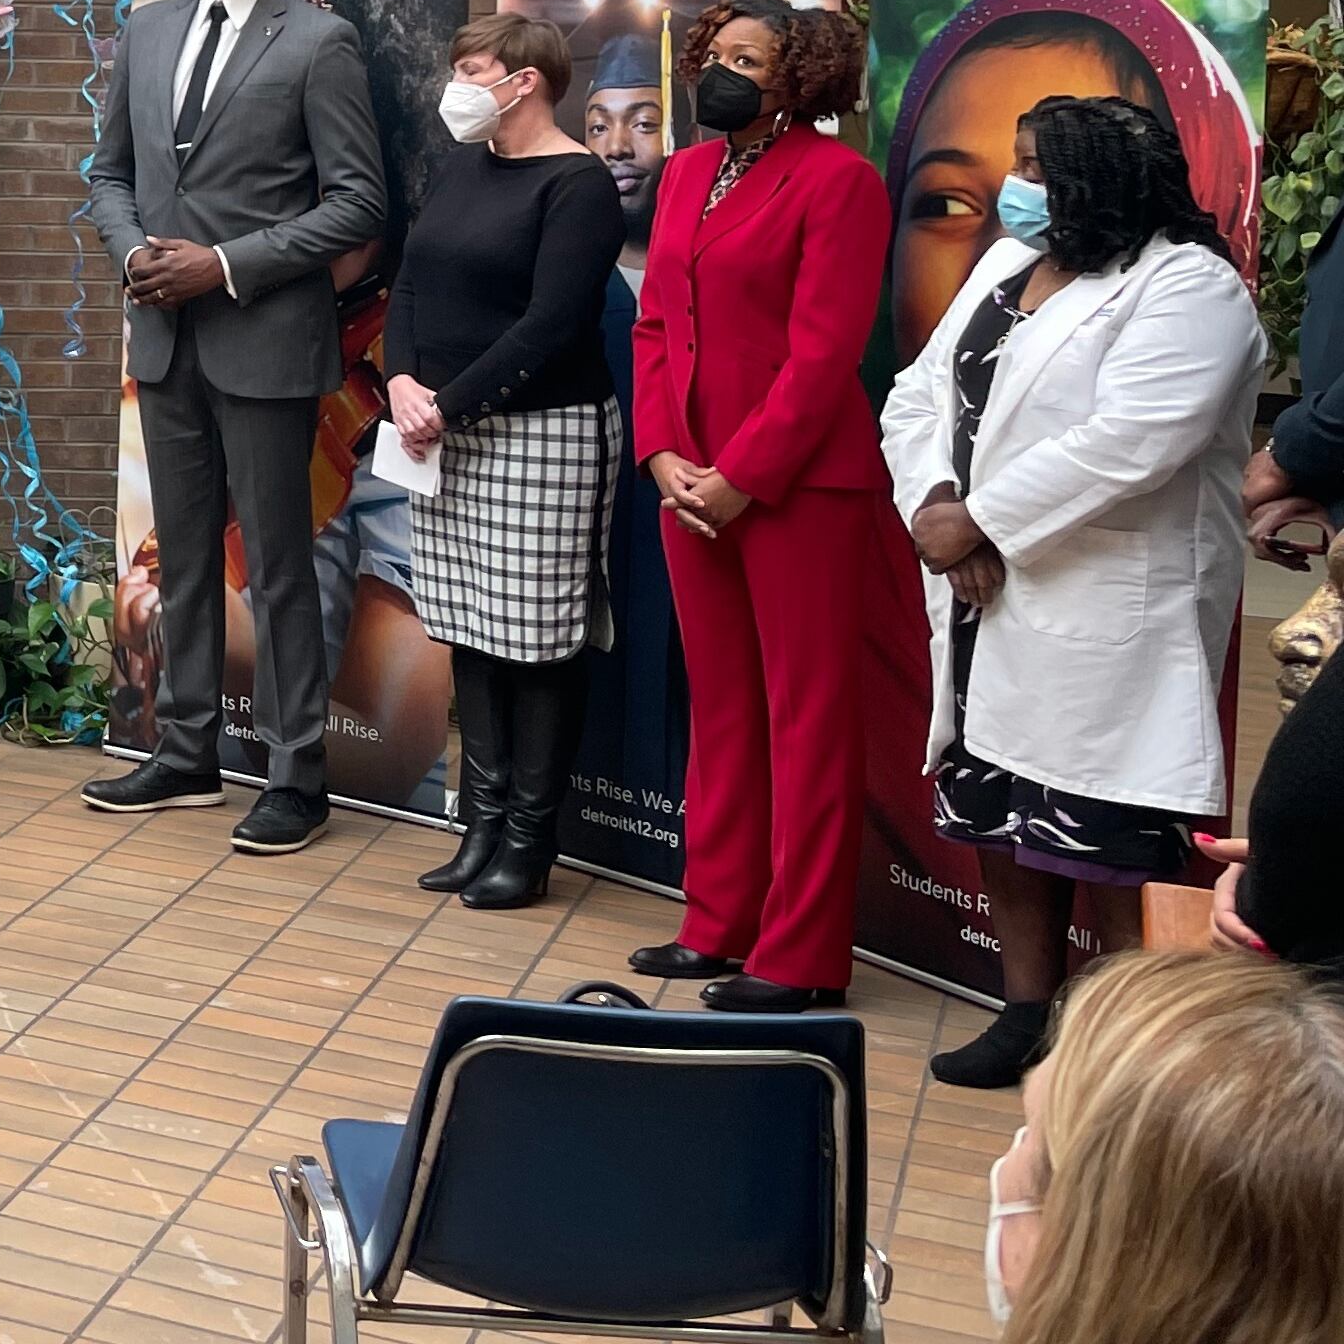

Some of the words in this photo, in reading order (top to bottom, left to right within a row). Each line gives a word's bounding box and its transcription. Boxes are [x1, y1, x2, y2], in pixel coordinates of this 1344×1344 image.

[342, 717, 384, 743] Rise.
[596, 777, 639, 806] Rise.
[641, 788, 673, 814] We
[580, 805, 679, 849] detroitk12.org
[889, 863, 973, 911] Students
[1066, 924, 1092, 951] All
